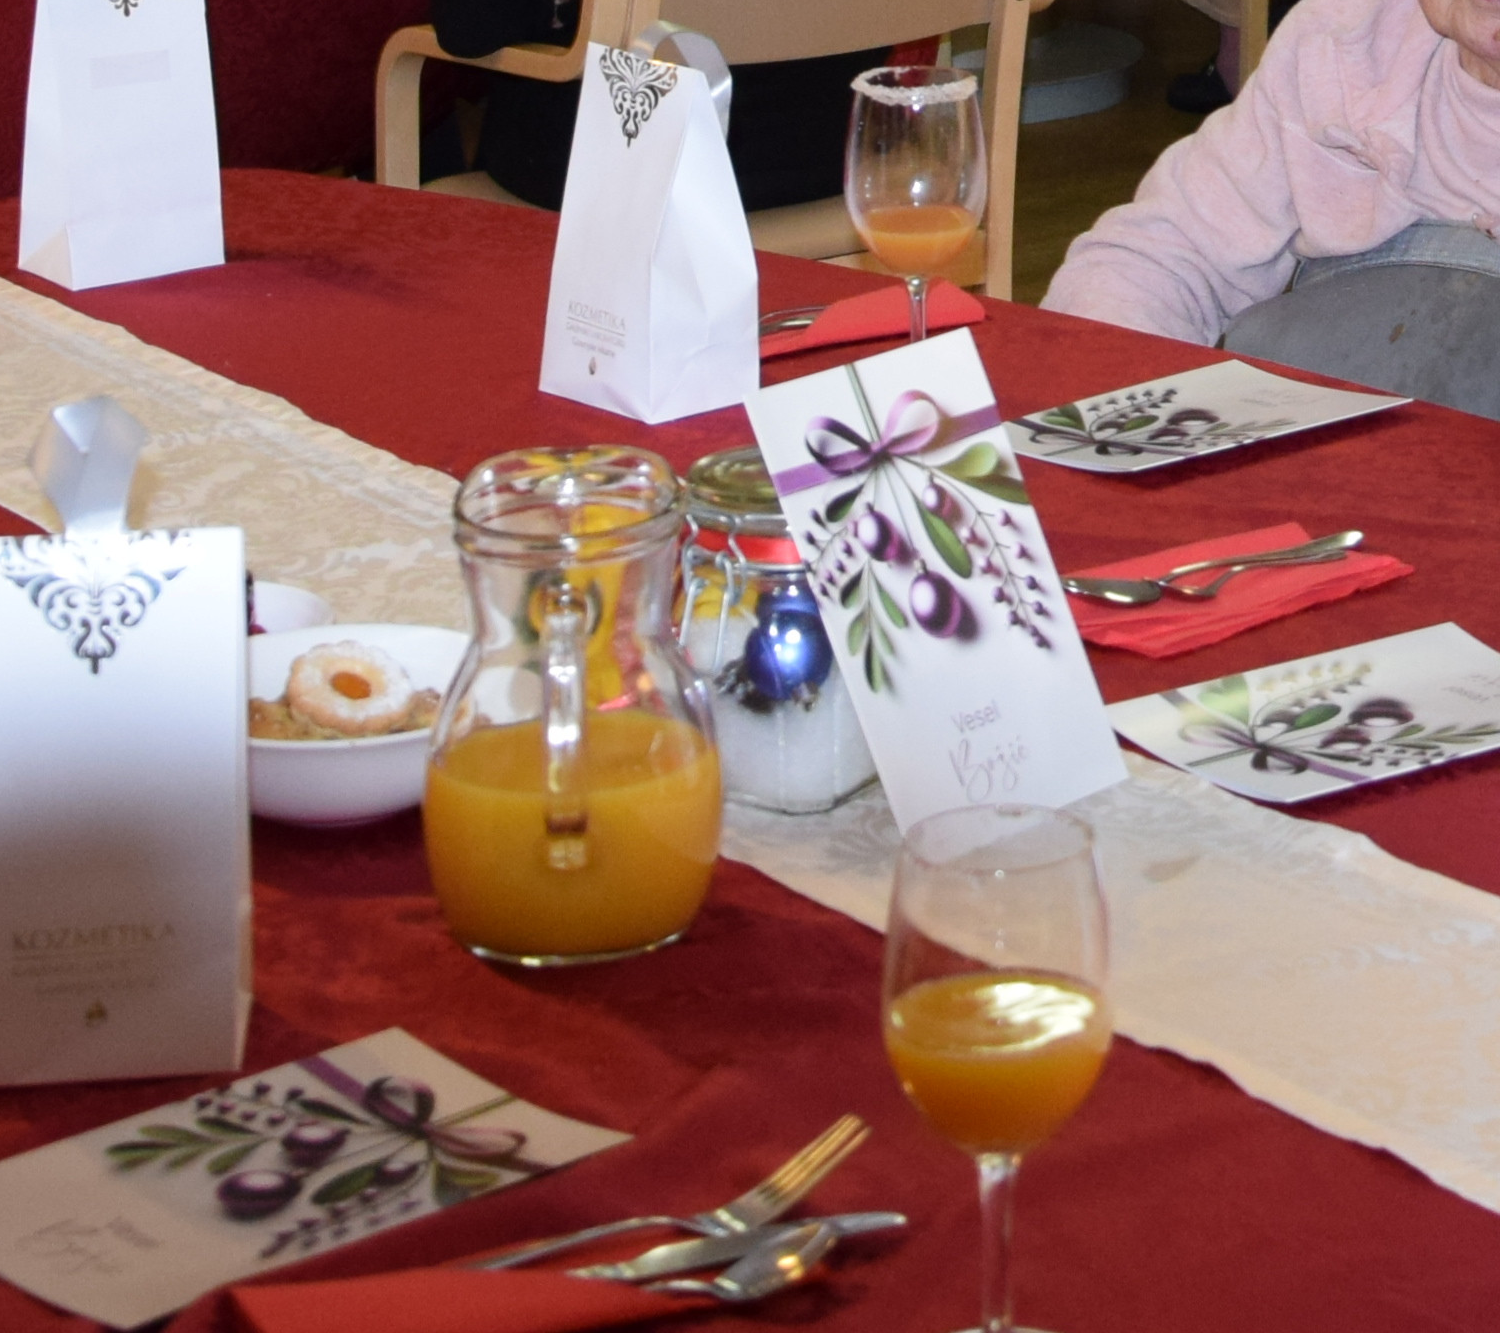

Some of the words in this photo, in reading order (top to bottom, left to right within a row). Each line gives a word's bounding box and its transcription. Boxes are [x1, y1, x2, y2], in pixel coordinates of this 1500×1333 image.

[568, 299, 626, 332] KOZMETIKA
[949, 698, 1002, 734] Vesel
[11, 921, 177, 951] KOZMETIKA
